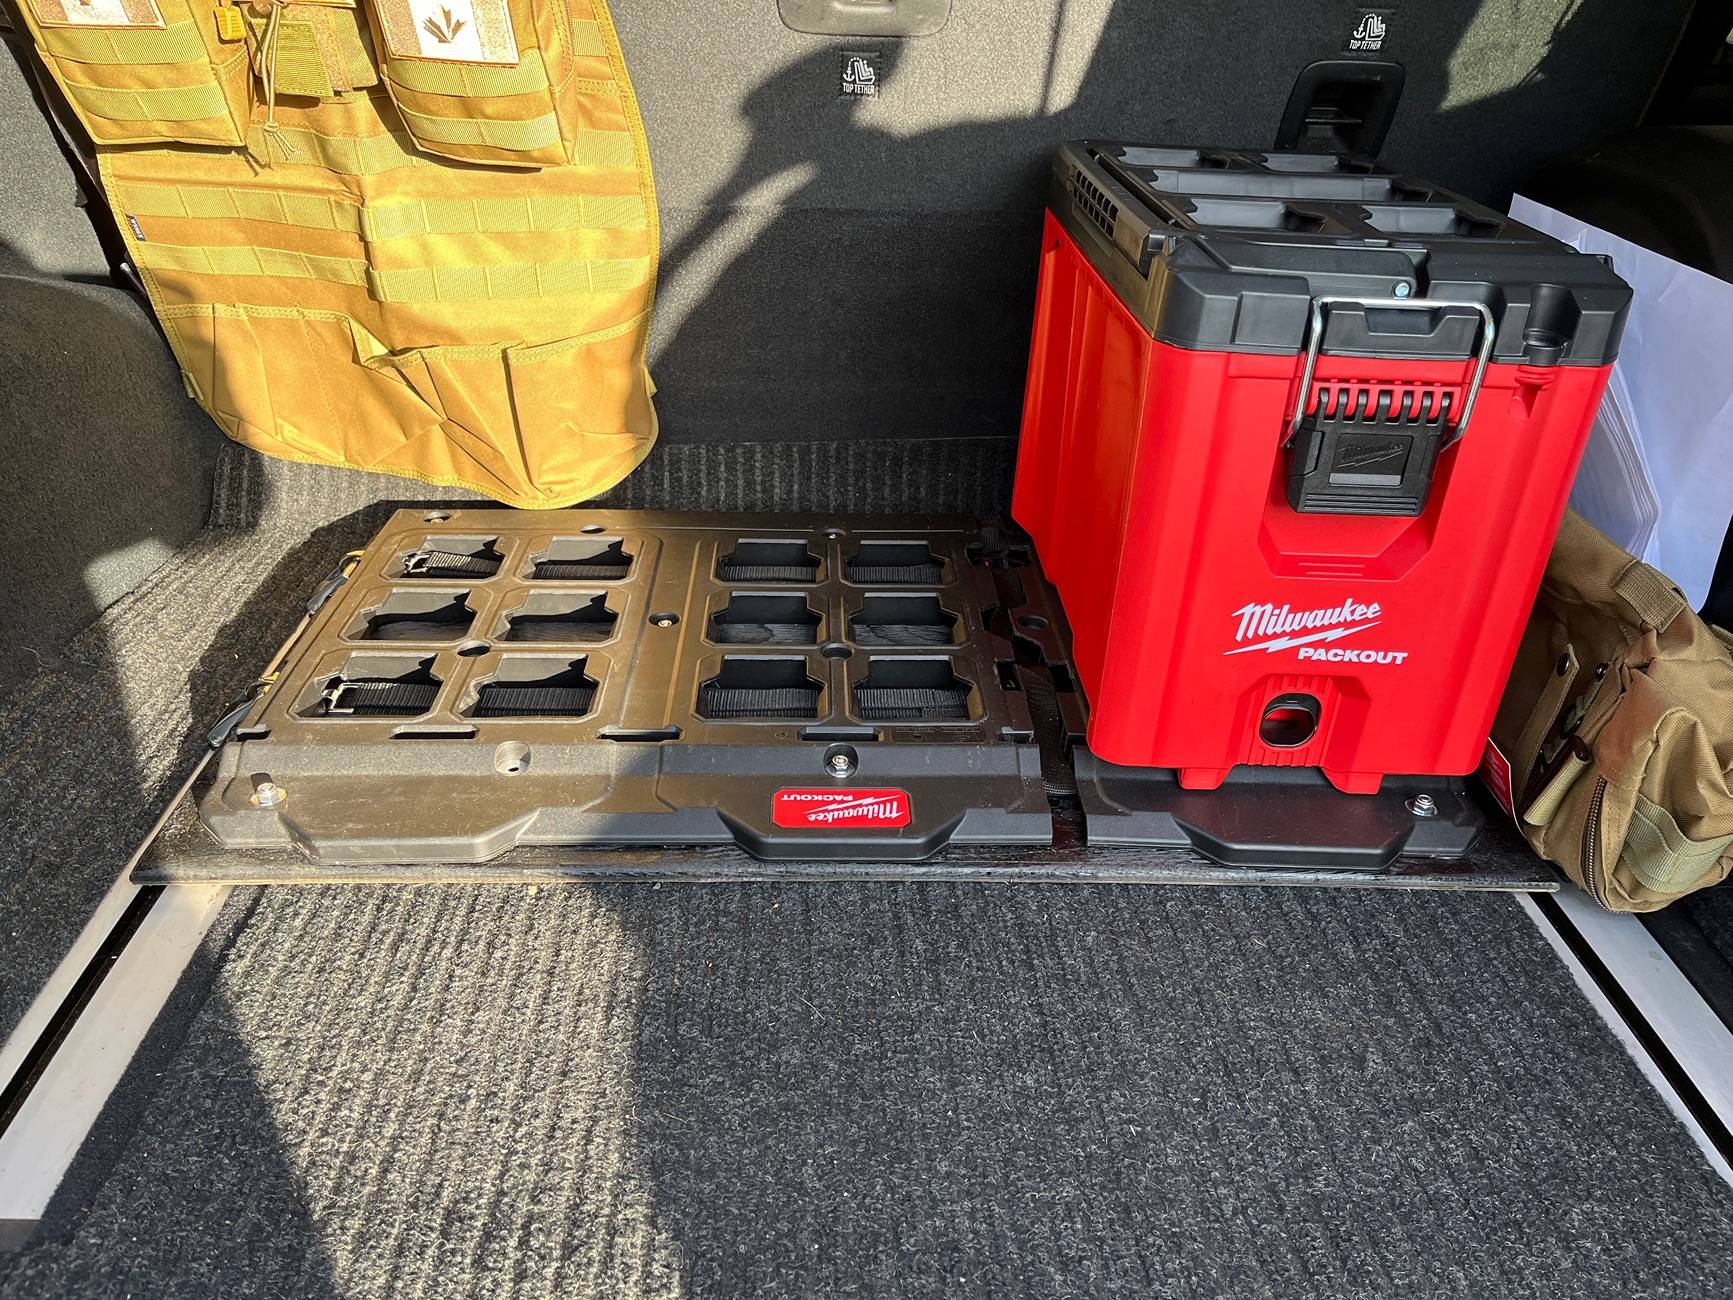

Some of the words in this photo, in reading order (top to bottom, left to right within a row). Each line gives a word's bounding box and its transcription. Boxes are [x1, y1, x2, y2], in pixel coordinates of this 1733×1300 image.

[1349, 40, 1361, 49] TOP
[1361, 41, 1382, 50] TETHER
[842, 82, 854, 93] TOP
[854, 84, 875, 94] TETHER
[1231, 598, 1382, 642] Milwaukee
[1297, 647, 1408, 665] PACKOUT
[806, 800, 905, 823] Milwaukee
